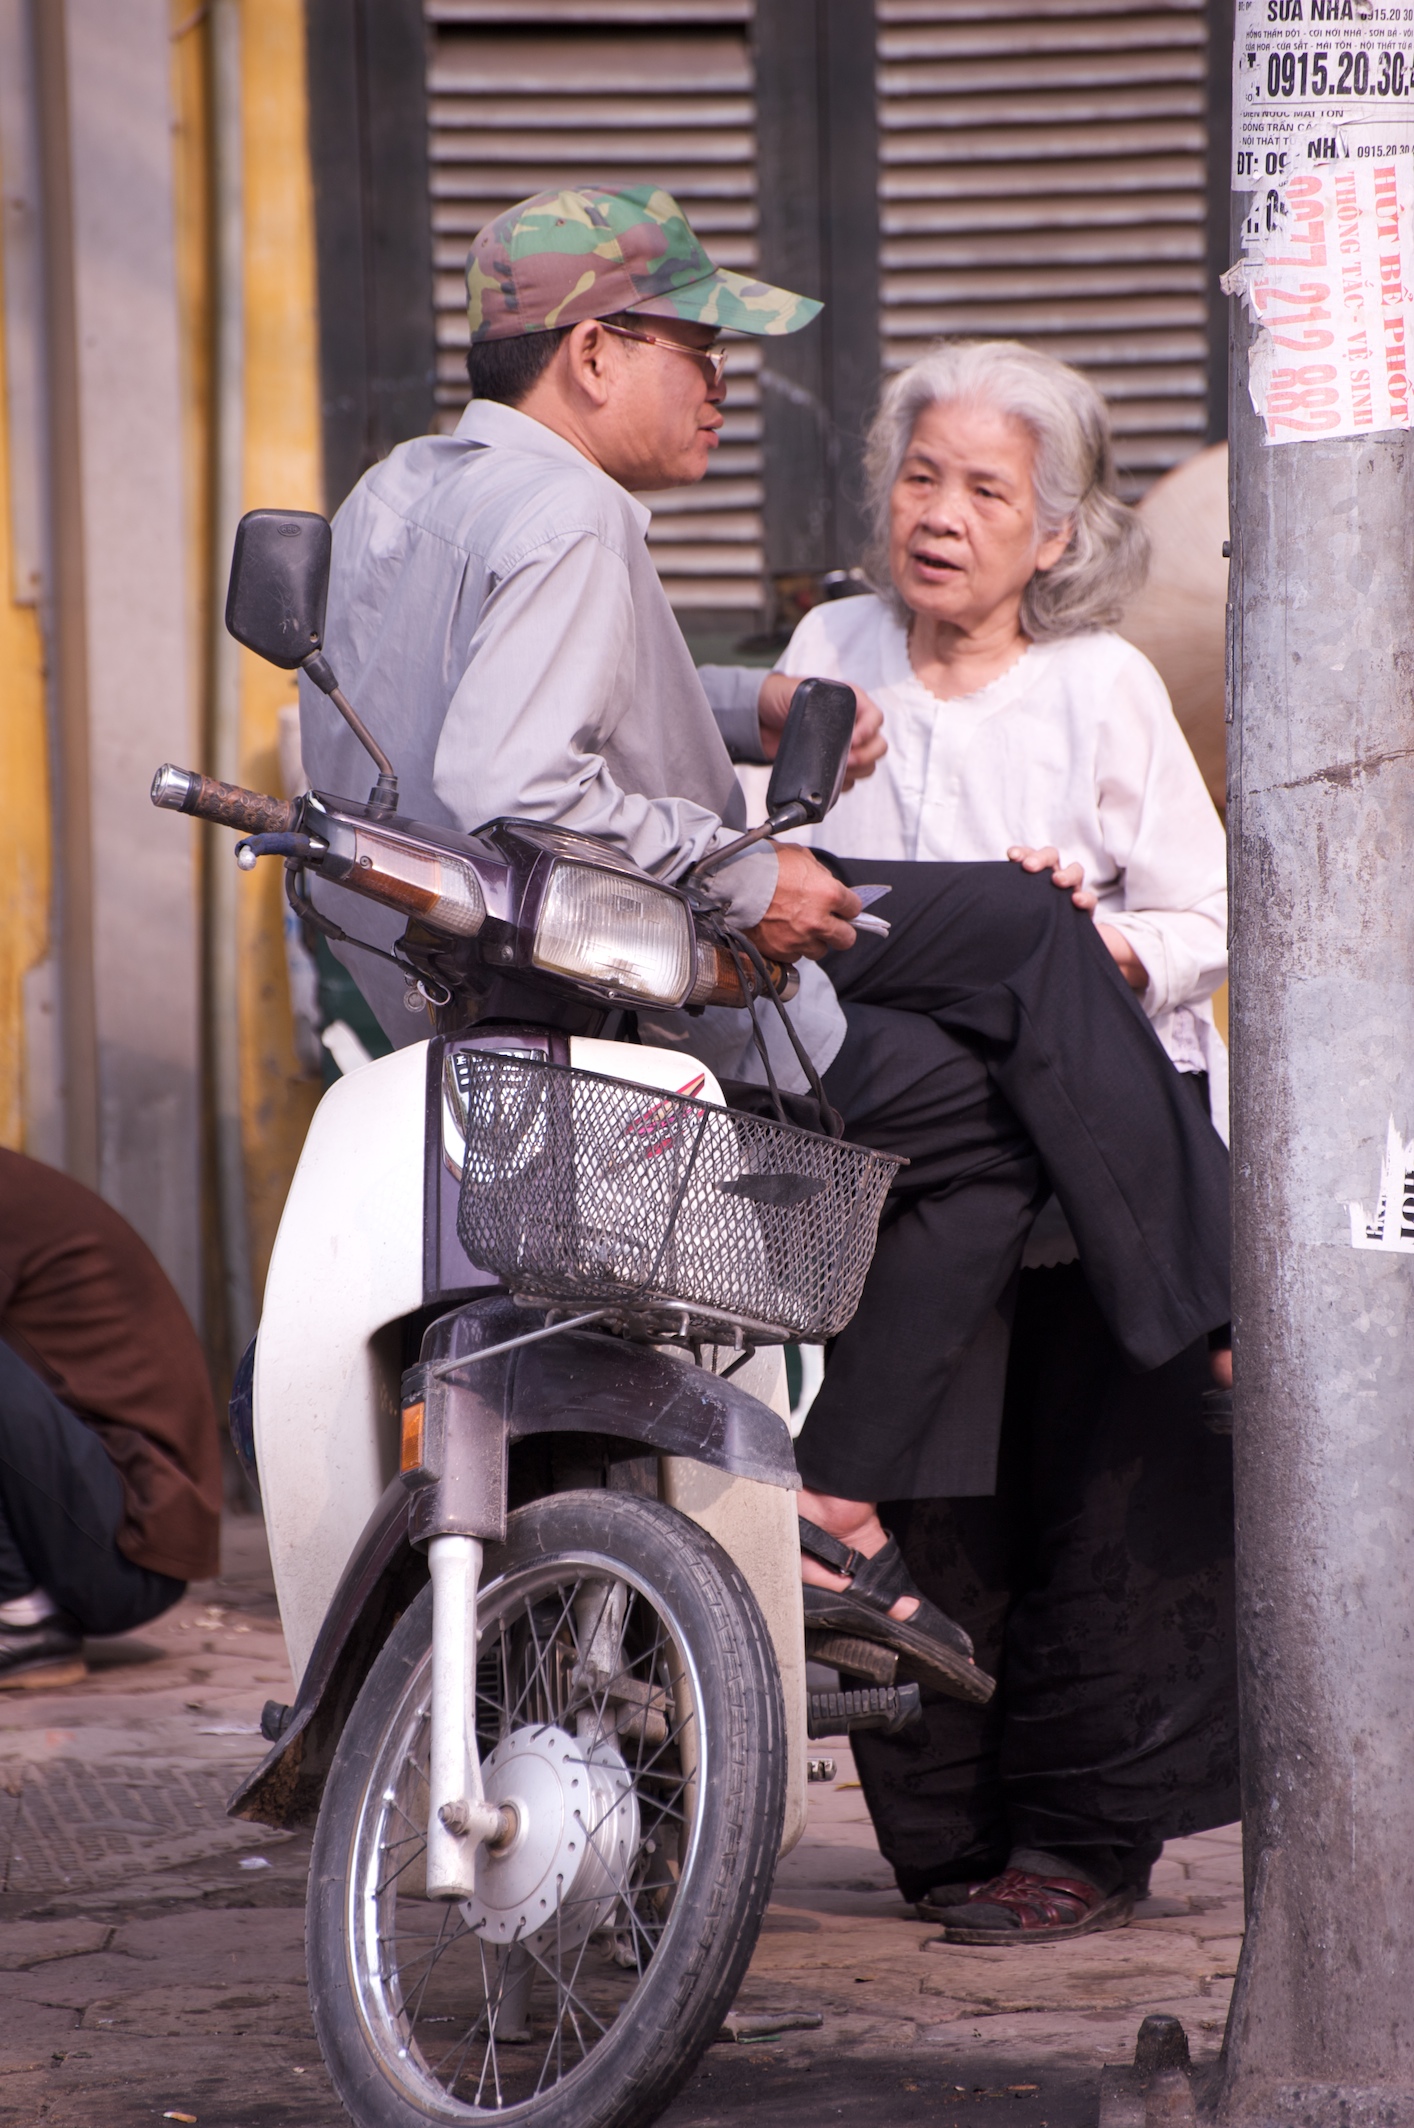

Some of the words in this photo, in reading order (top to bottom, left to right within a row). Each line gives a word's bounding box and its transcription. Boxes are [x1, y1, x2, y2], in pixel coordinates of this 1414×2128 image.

[1334, 170, 1363, 255] THÔNG
[1373, 163, 1406, 244] HÚT
[1341, 260, 1375, 310] TẮC
[1379, 251, 1413, 307] BỂ
[1342, 329, 1373, 362] VỆ
[1384, 314, 1414, 424] PHỐT
[1350, 368, 1374, 427] SINH
